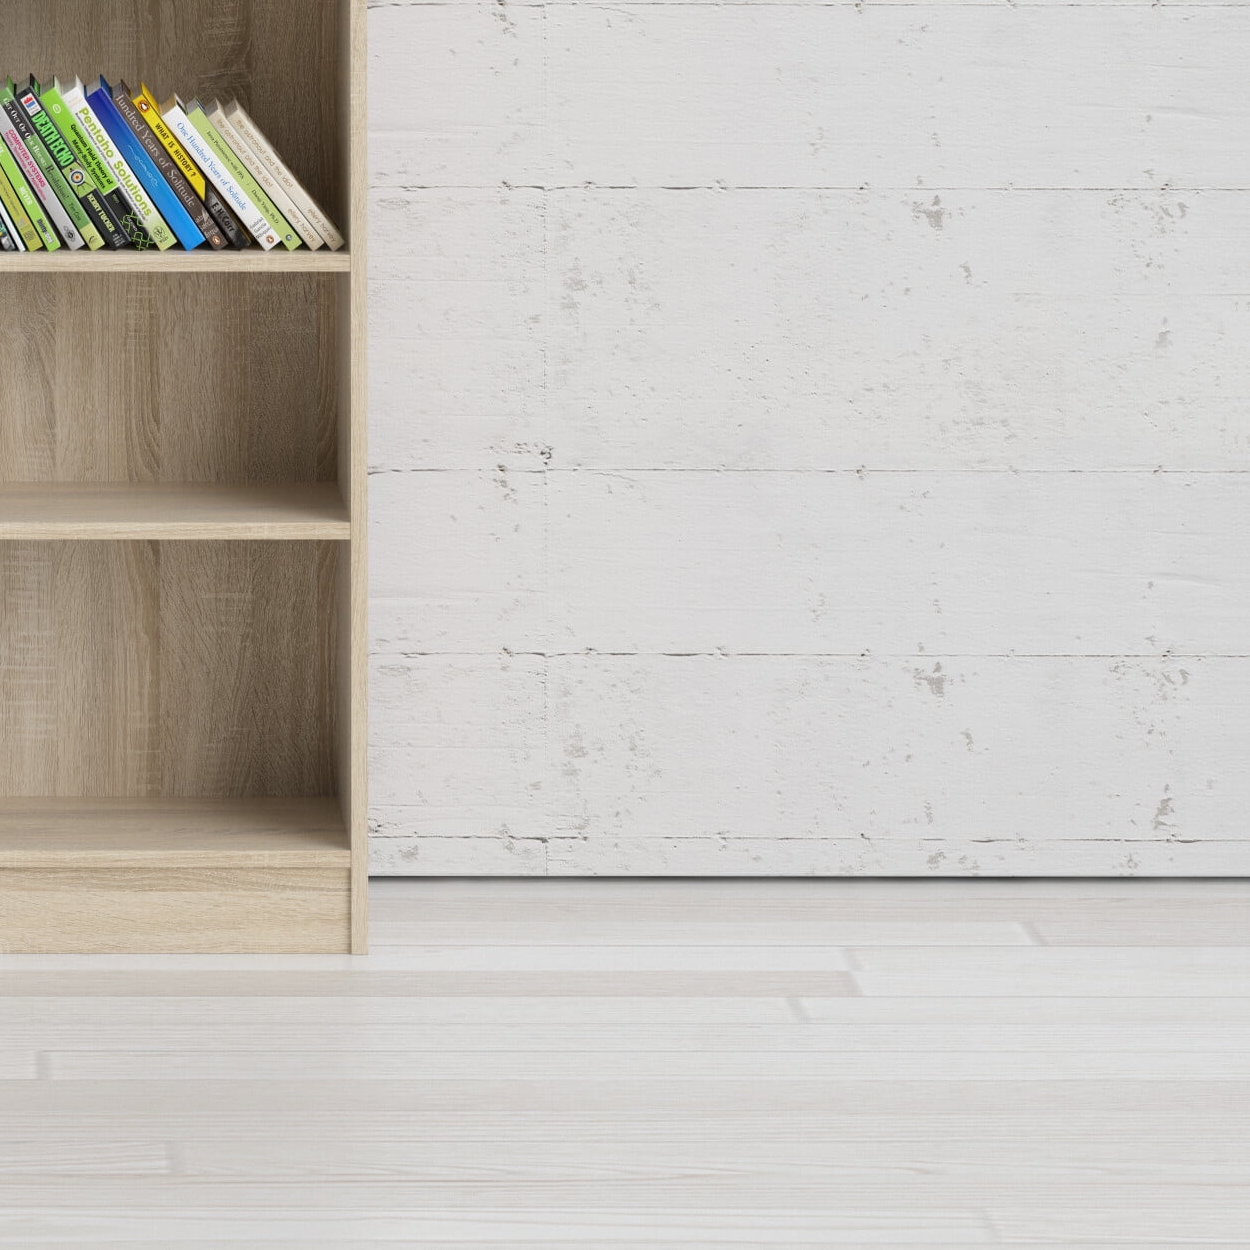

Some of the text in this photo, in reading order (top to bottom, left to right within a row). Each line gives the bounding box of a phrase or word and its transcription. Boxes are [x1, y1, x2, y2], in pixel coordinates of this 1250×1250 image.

[7, 128, 46, 188] COMPUTER SYSTEMS
[30, 109, 60, 145] DEATH
[48, 137, 75, 167] ECHO
[69, 123, 112, 185] Quantum Field Theory of
[70, 138, 106, 189] Many-Body Systems
[77, 105, 116, 159] Pentaho
[112, 159, 154, 217] Solutions
[153, 122, 170, 141] WHAT
[167, 140, 175, 148] IS
[173, 148, 194, 173] HISTORY
[175, 121, 248, 211] One Hundred Years of Solitude
[139, 130, 163, 158] Years
[158, 156, 171, 169] of
[166, 168, 197, 207] Solitude
[86, 192, 115, 233] KERRY TUCKER
